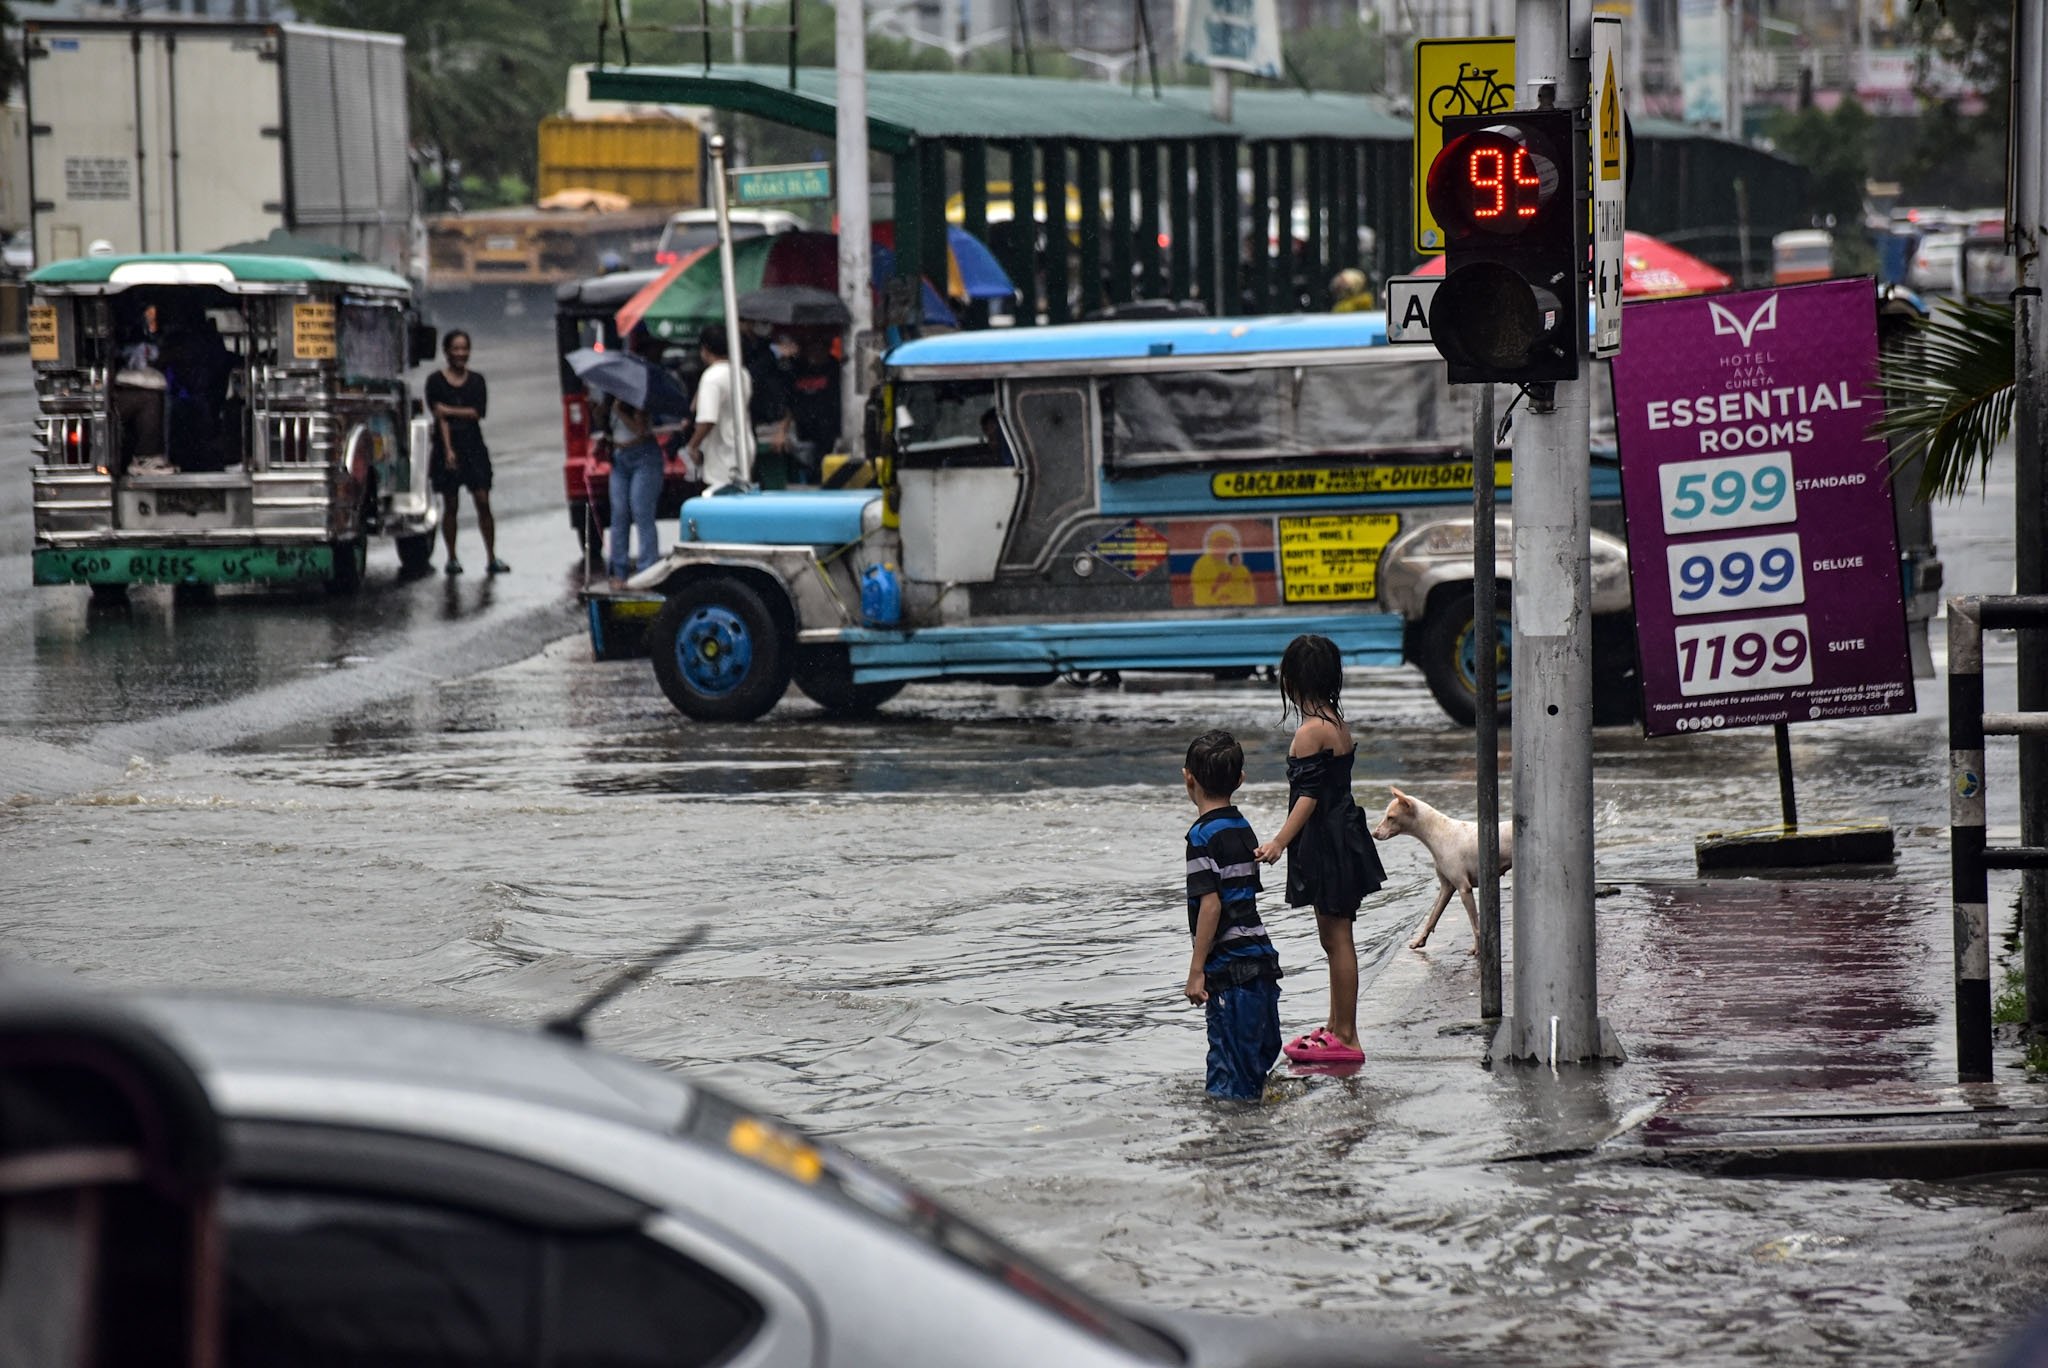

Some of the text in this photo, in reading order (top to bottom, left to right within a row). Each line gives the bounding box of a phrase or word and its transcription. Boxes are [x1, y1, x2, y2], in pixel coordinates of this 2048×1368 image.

[1719, 351, 1776, 367] HOTEL
[1725, 376, 1775, 390] CUNETA
[1733, 365, 1765, 379] AVA
[1646, 380, 1863, 430] ESSENTIAL
[1699, 419, 1814, 454] ROOMS
[1233, 465, 1480, 493] BACLARAN DIVISORI
[1670, 465, 1866, 520] 599 STANDARD
[1678, 547, 1864, 601] 999 DELUXE
[1679, 628, 1865, 683] 1199 SUITE
[1699, 698, 1729, 708] subject
[1740, 693, 1785, 704] availability
[1791, 690, 1804, 698] For
[1806, 686, 1857, 697] reservations
[1865, 682, 1904, 691] inquiries:
[1810, 697, 1832, 705] Viber
